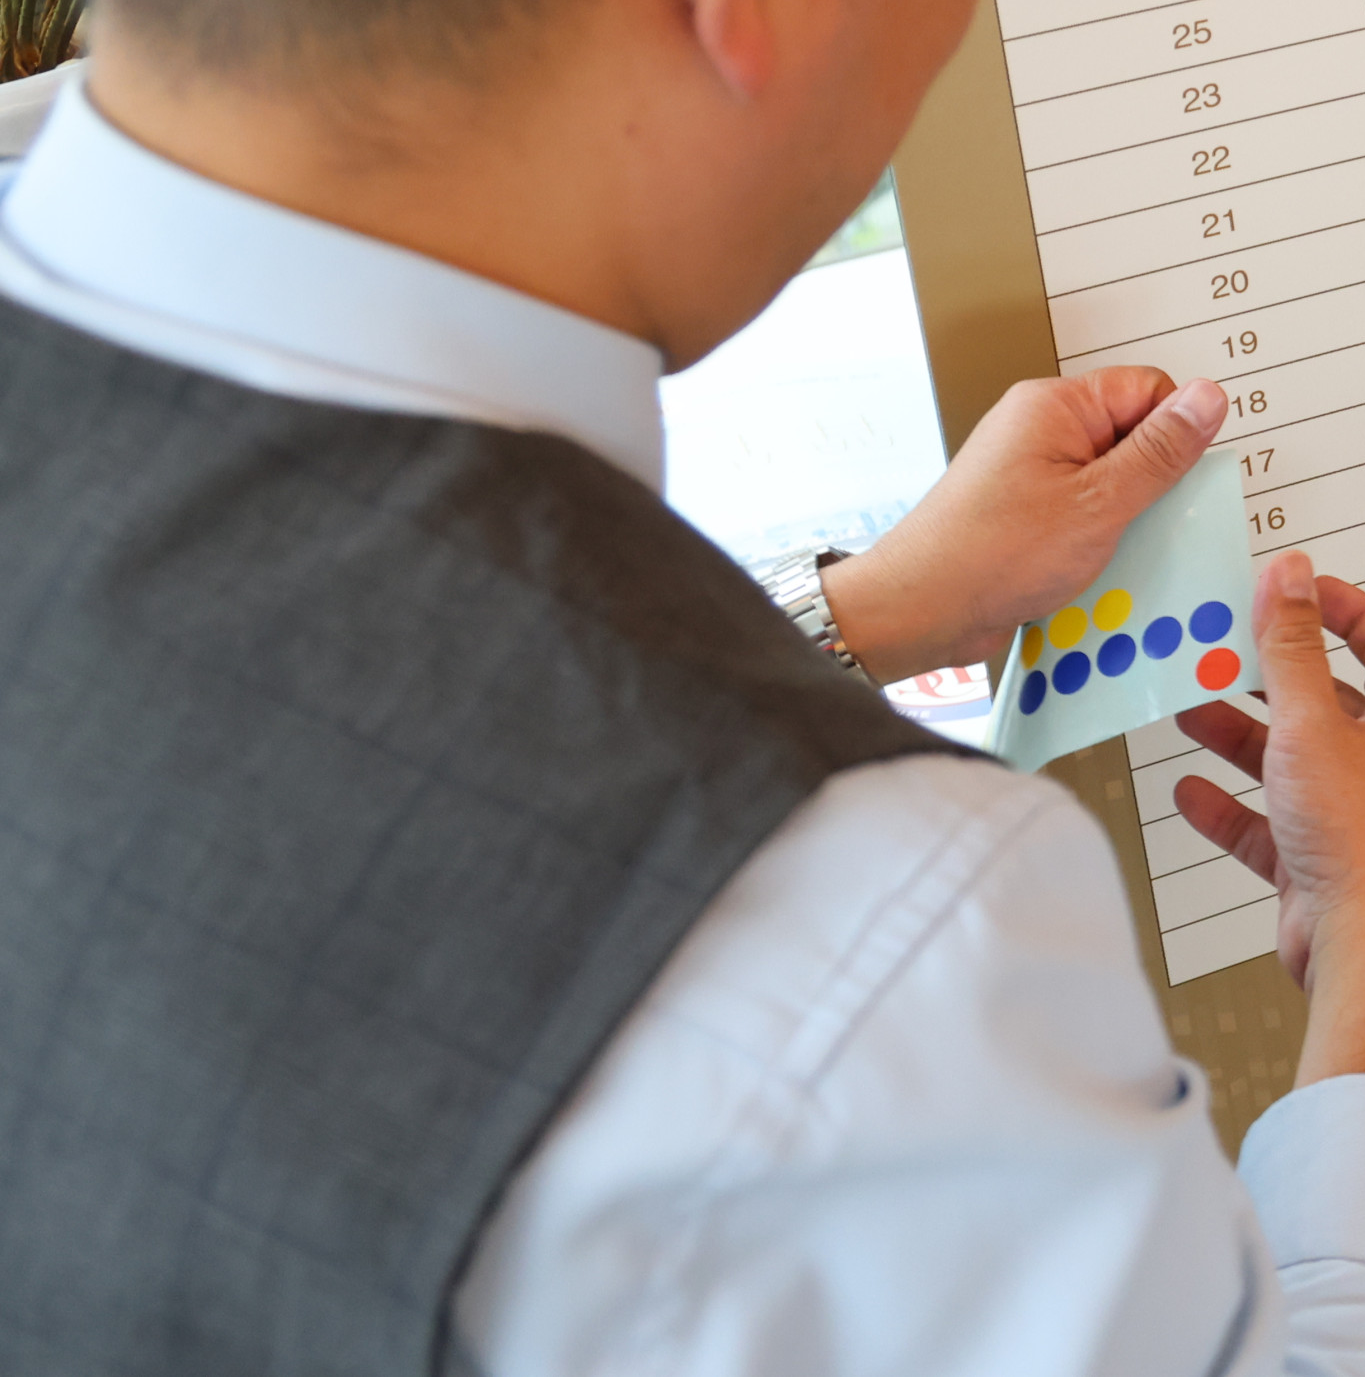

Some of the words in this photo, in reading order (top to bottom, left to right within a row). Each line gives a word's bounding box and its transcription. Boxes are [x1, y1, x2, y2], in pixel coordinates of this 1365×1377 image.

[1173, 19, 1211, 49] 25
[1183, 83, 1221, 113] 23
[1192, 146, 1231, 176] 22
[1202, 209, 1235, 238] 21
[1211, 270, 1248, 299] 20
[1222, 331, 1257, 358] 19
[1231, 390, 1267, 417] 18
[1241, 448, 1274, 477] 17
[1250, 507, 1285, 534] 16
